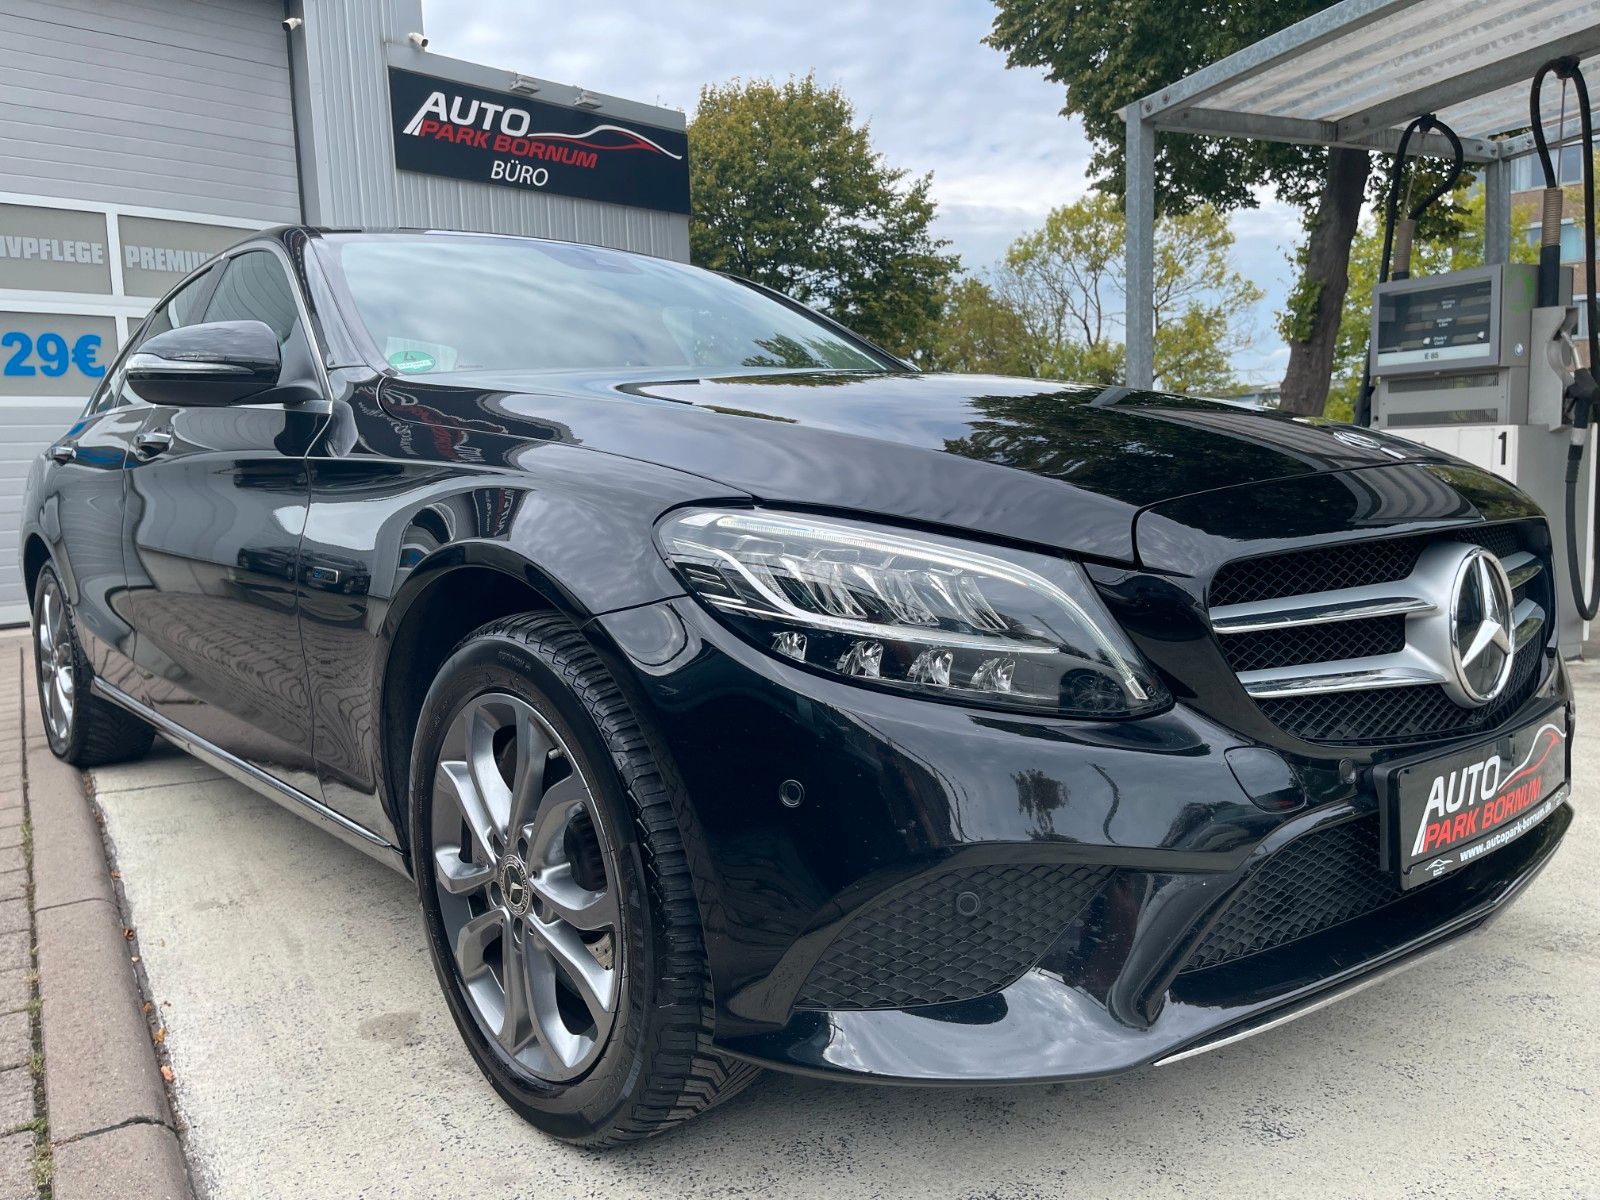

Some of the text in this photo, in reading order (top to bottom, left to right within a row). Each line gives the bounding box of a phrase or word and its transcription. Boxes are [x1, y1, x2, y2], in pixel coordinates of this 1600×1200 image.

[403, 91, 531, 137] AUTO
[419, 119, 598, 169] PARK BORNUM
[490, 159, 549, 186] BÜRO
[1, 331, 106, 378] 29€
[1497, 431, 1508, 466] 1
[1411, 755, 1501, 857] AUTO
[1423, 775, 1543, 853] PARK BORNUM
